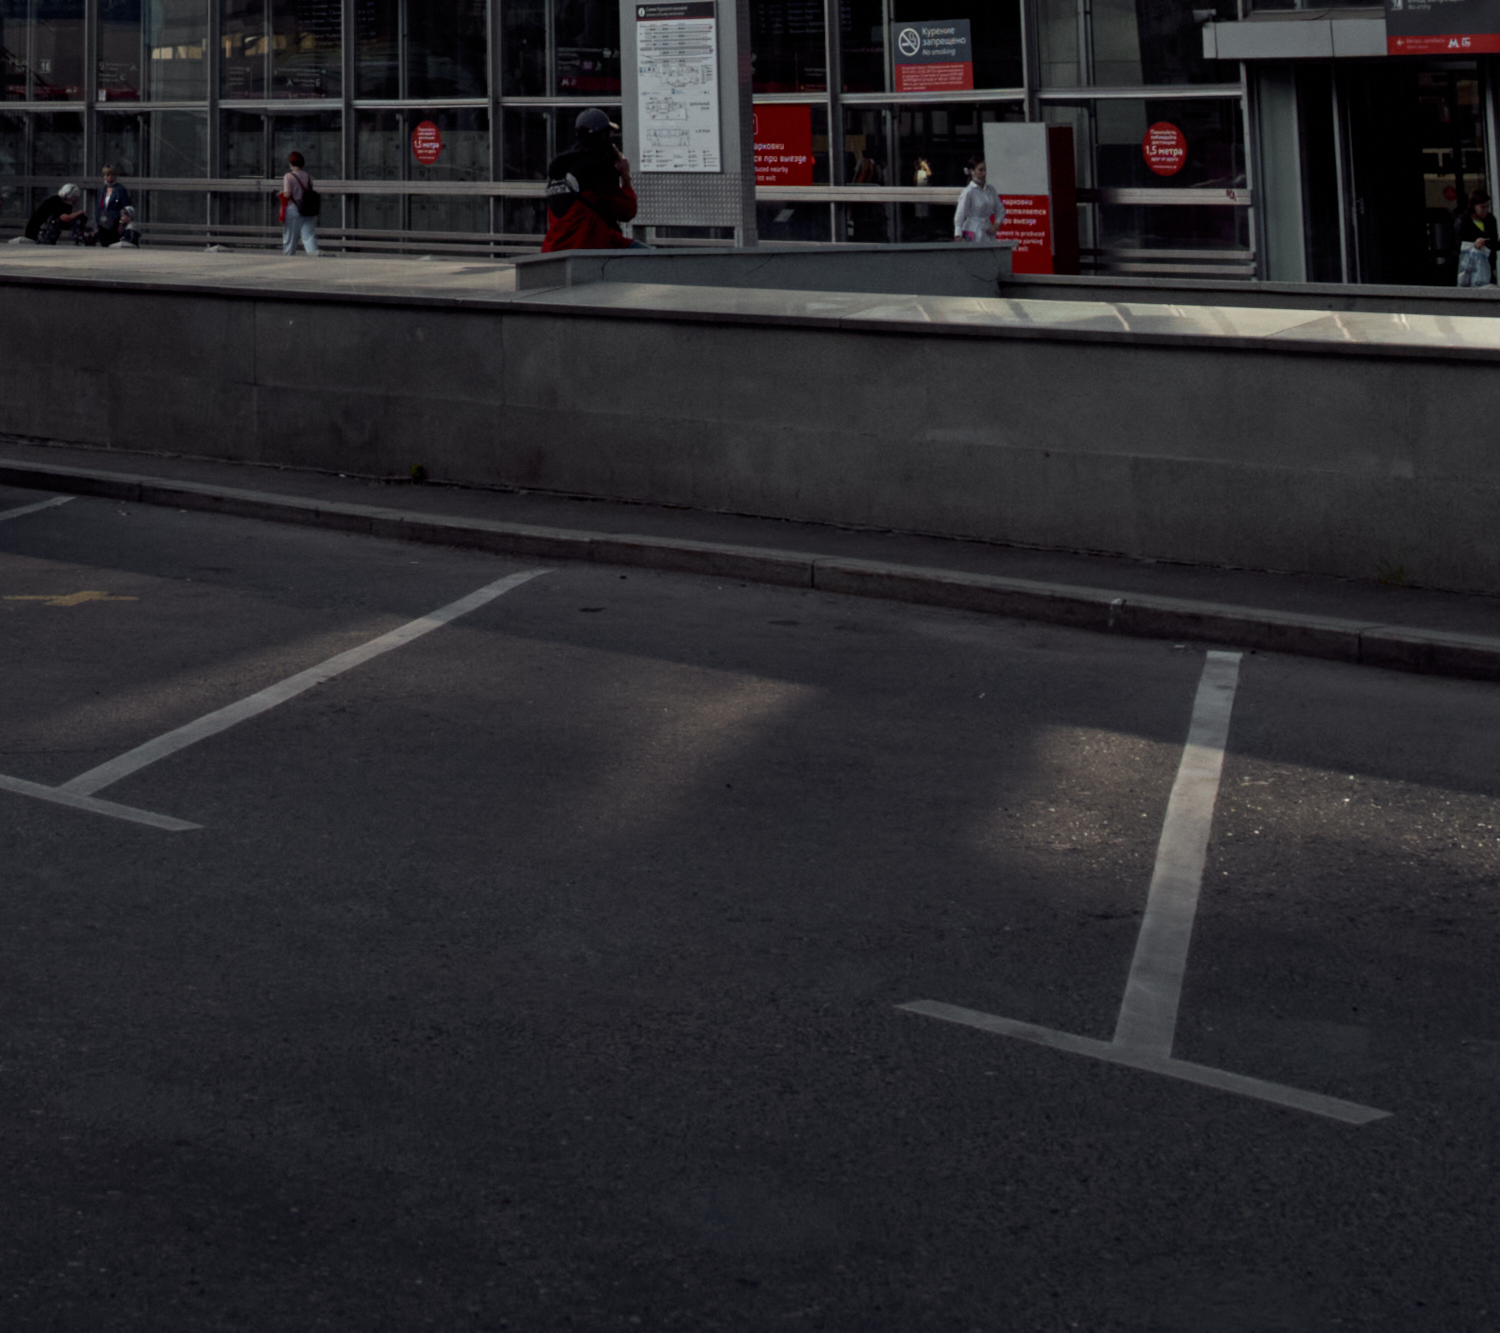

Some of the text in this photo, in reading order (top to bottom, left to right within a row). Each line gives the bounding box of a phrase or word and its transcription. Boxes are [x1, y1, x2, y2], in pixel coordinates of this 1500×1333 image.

[921, 27, 956, 38] Курение
[921, 37, 967, 47] запрещено
[754, 143, 785, 152] арковки
[1145, 145, 1157, 156] 1,5
